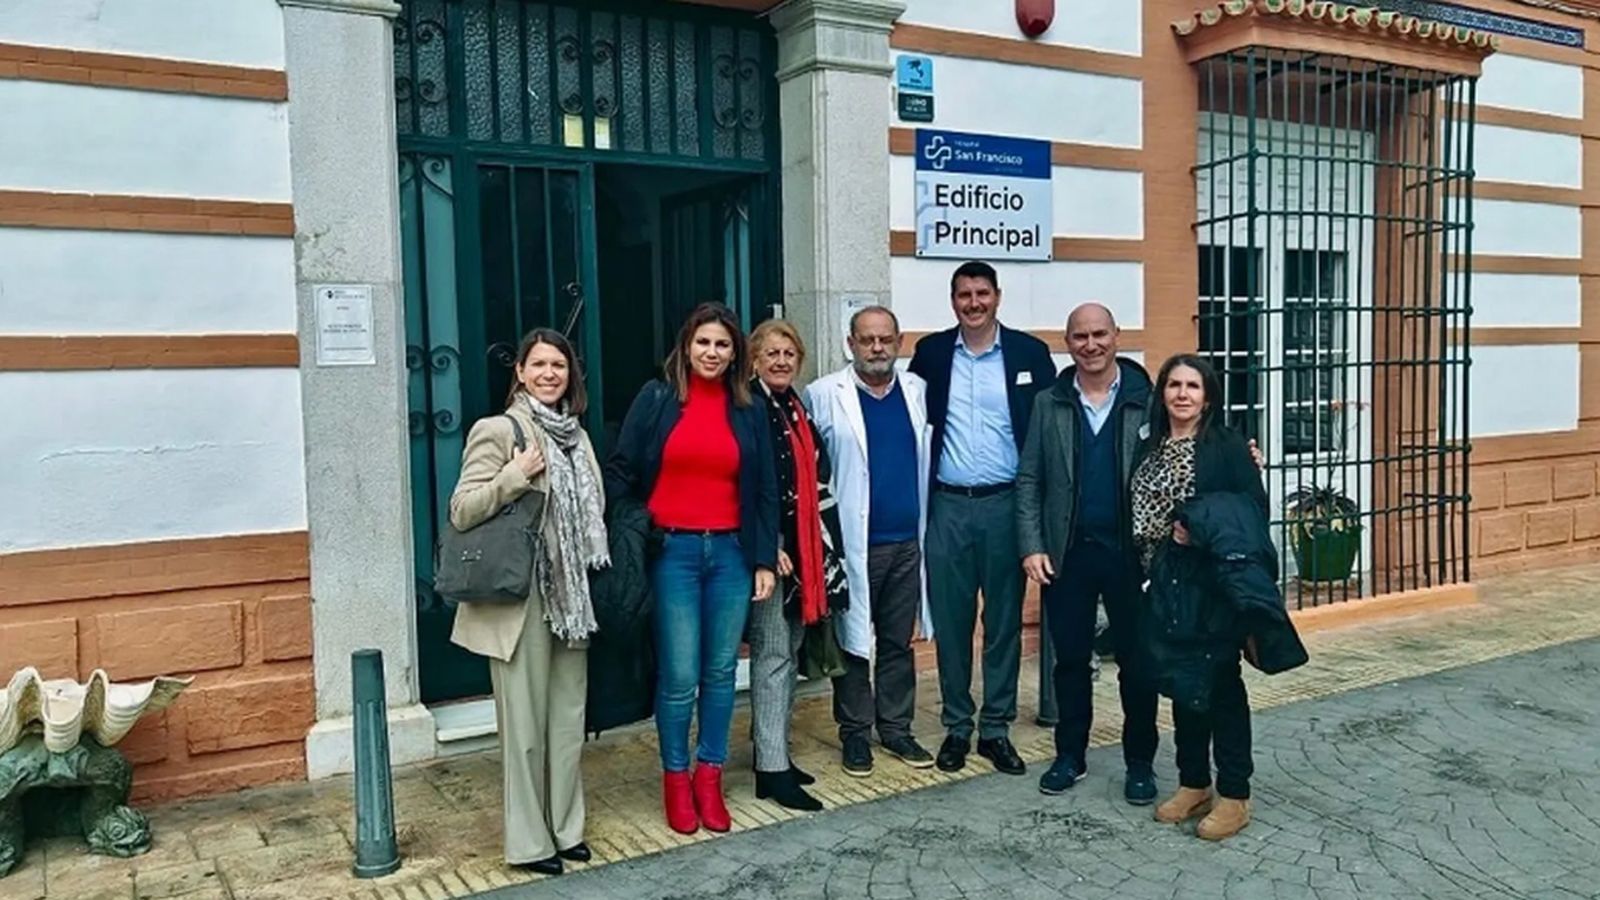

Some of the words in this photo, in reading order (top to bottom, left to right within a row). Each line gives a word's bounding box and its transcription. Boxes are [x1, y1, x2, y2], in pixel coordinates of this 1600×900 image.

[954, 150, 974, 161] San
[976, 151, 1023, 165] Francisco
[935, 184, 1024, 211] Edificio
[935, 221, 1040, 251] Principal
